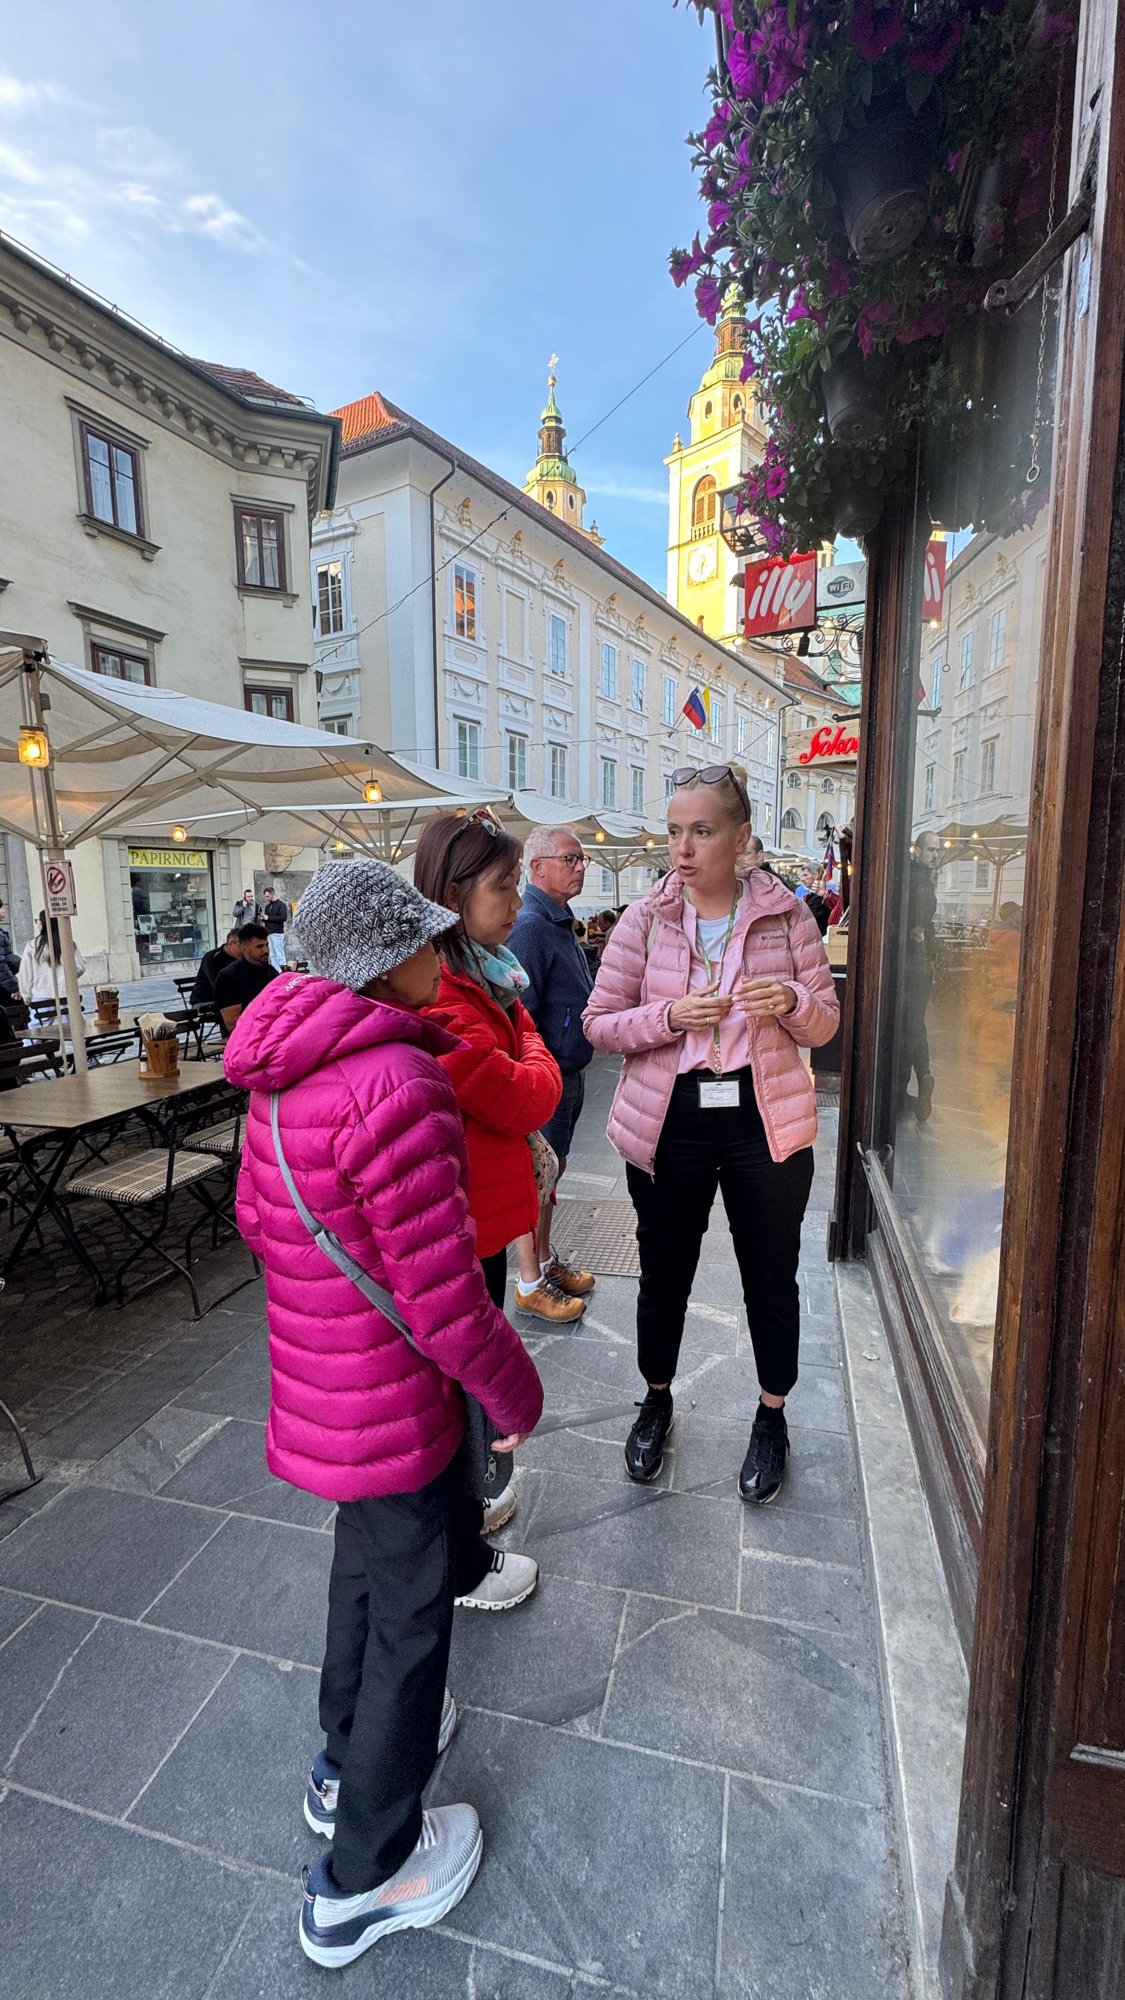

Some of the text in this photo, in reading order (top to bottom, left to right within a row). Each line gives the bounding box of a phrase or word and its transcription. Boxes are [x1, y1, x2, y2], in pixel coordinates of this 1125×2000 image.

[749, 565, 812, 624] illy
[799, 725, 861, 764] Soko
[130, 852, 205, 866] PAPIRNICA
